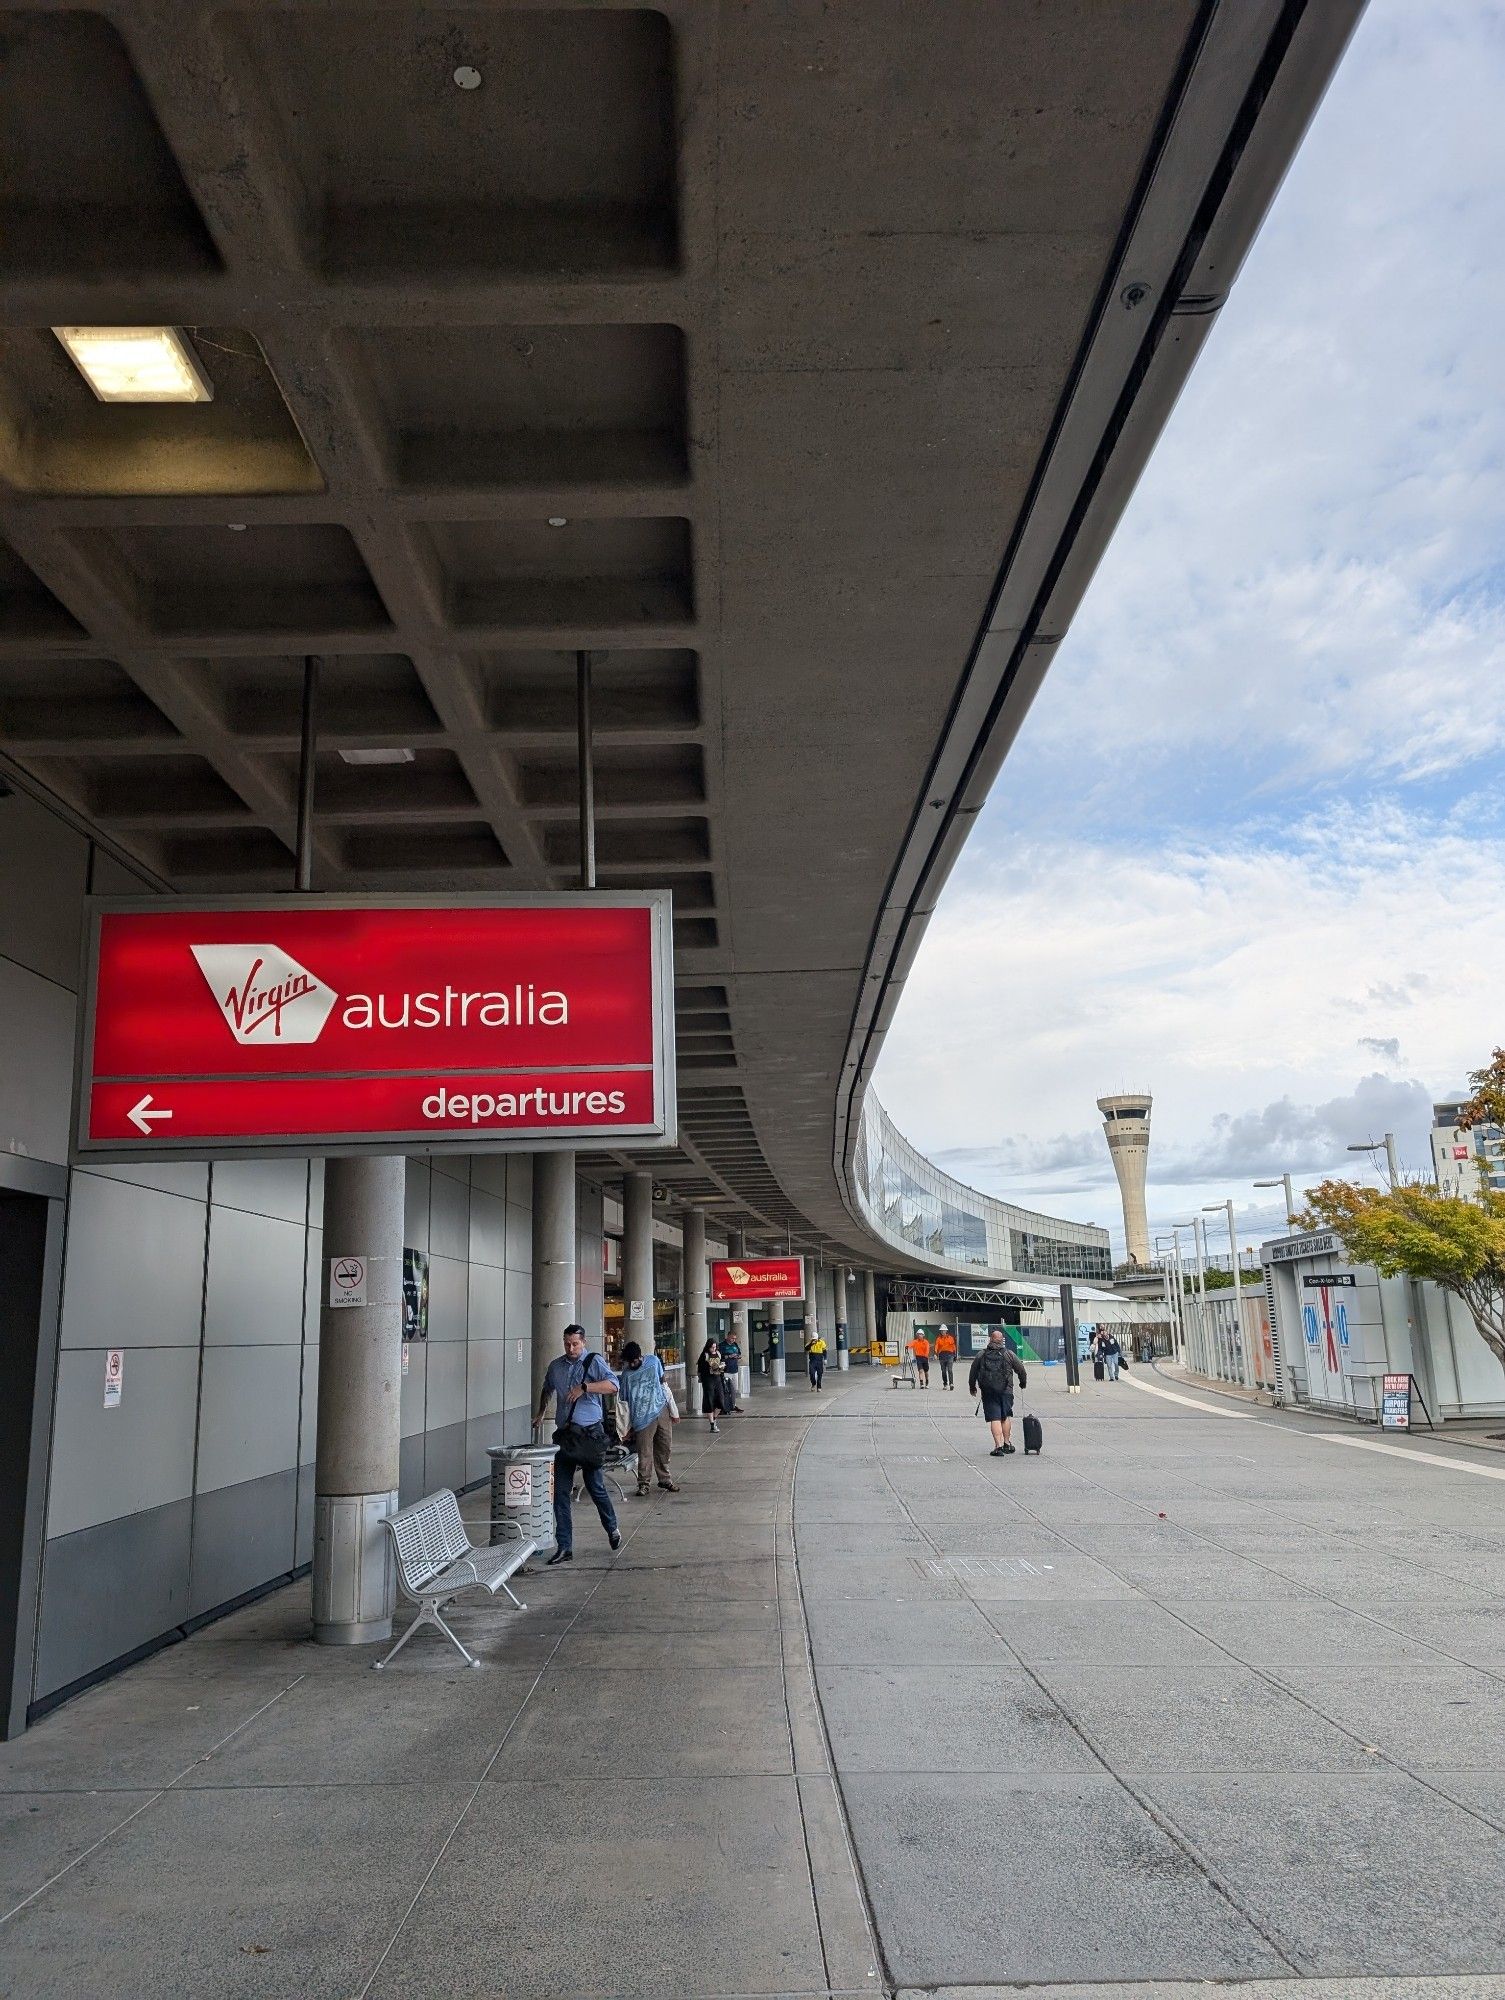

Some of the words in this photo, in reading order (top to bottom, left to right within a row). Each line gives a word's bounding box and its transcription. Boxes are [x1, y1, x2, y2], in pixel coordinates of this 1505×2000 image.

[225, 958, 317, 1037] Virgin
[342, 984, 568, 1029] australia
[422, 1087, 625, 1123] departures
[750, 1272, 788, 1282] australia
[1384, 1399, 1408, 1408] AIRPORT
